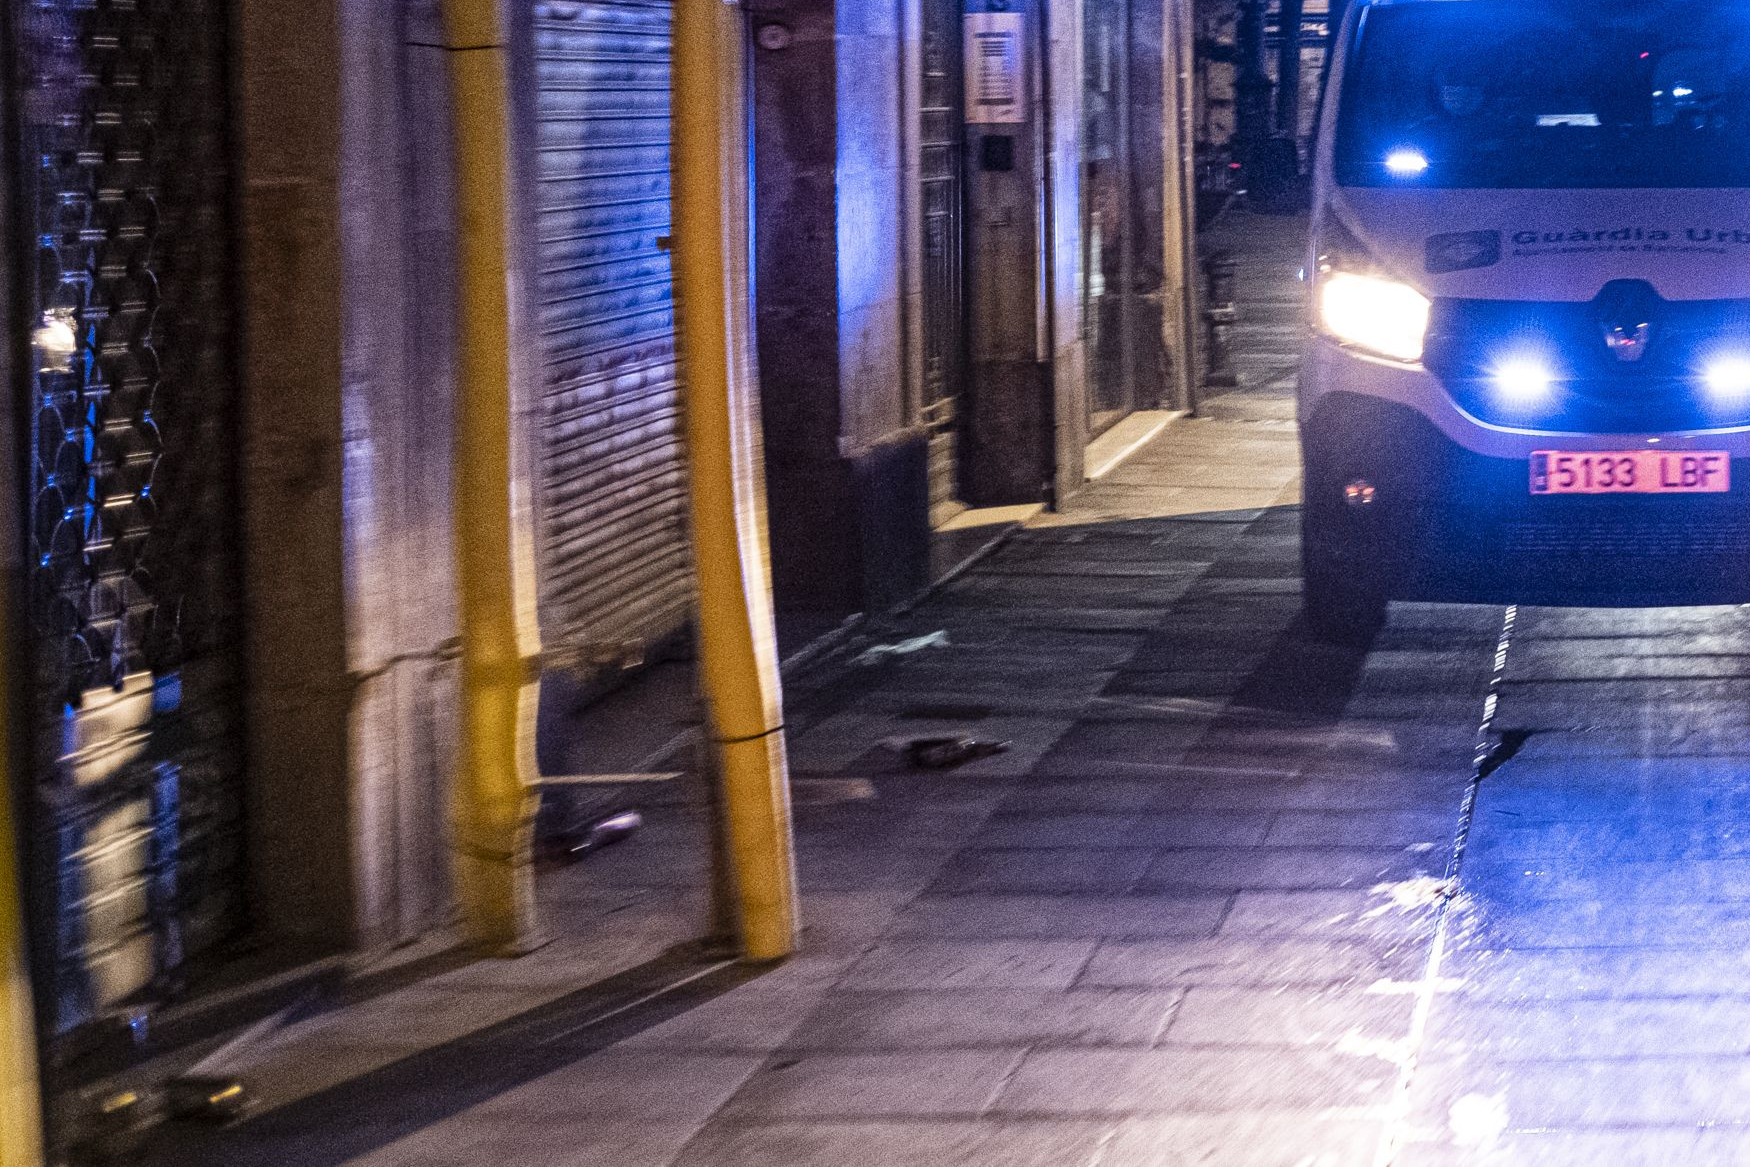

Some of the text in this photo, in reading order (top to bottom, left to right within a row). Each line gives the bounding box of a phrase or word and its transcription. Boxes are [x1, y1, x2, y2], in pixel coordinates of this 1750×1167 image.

[1511, 227, 1670, 245] Guàrdia
[1557, 457, 1720, 487] 5133 LBF
